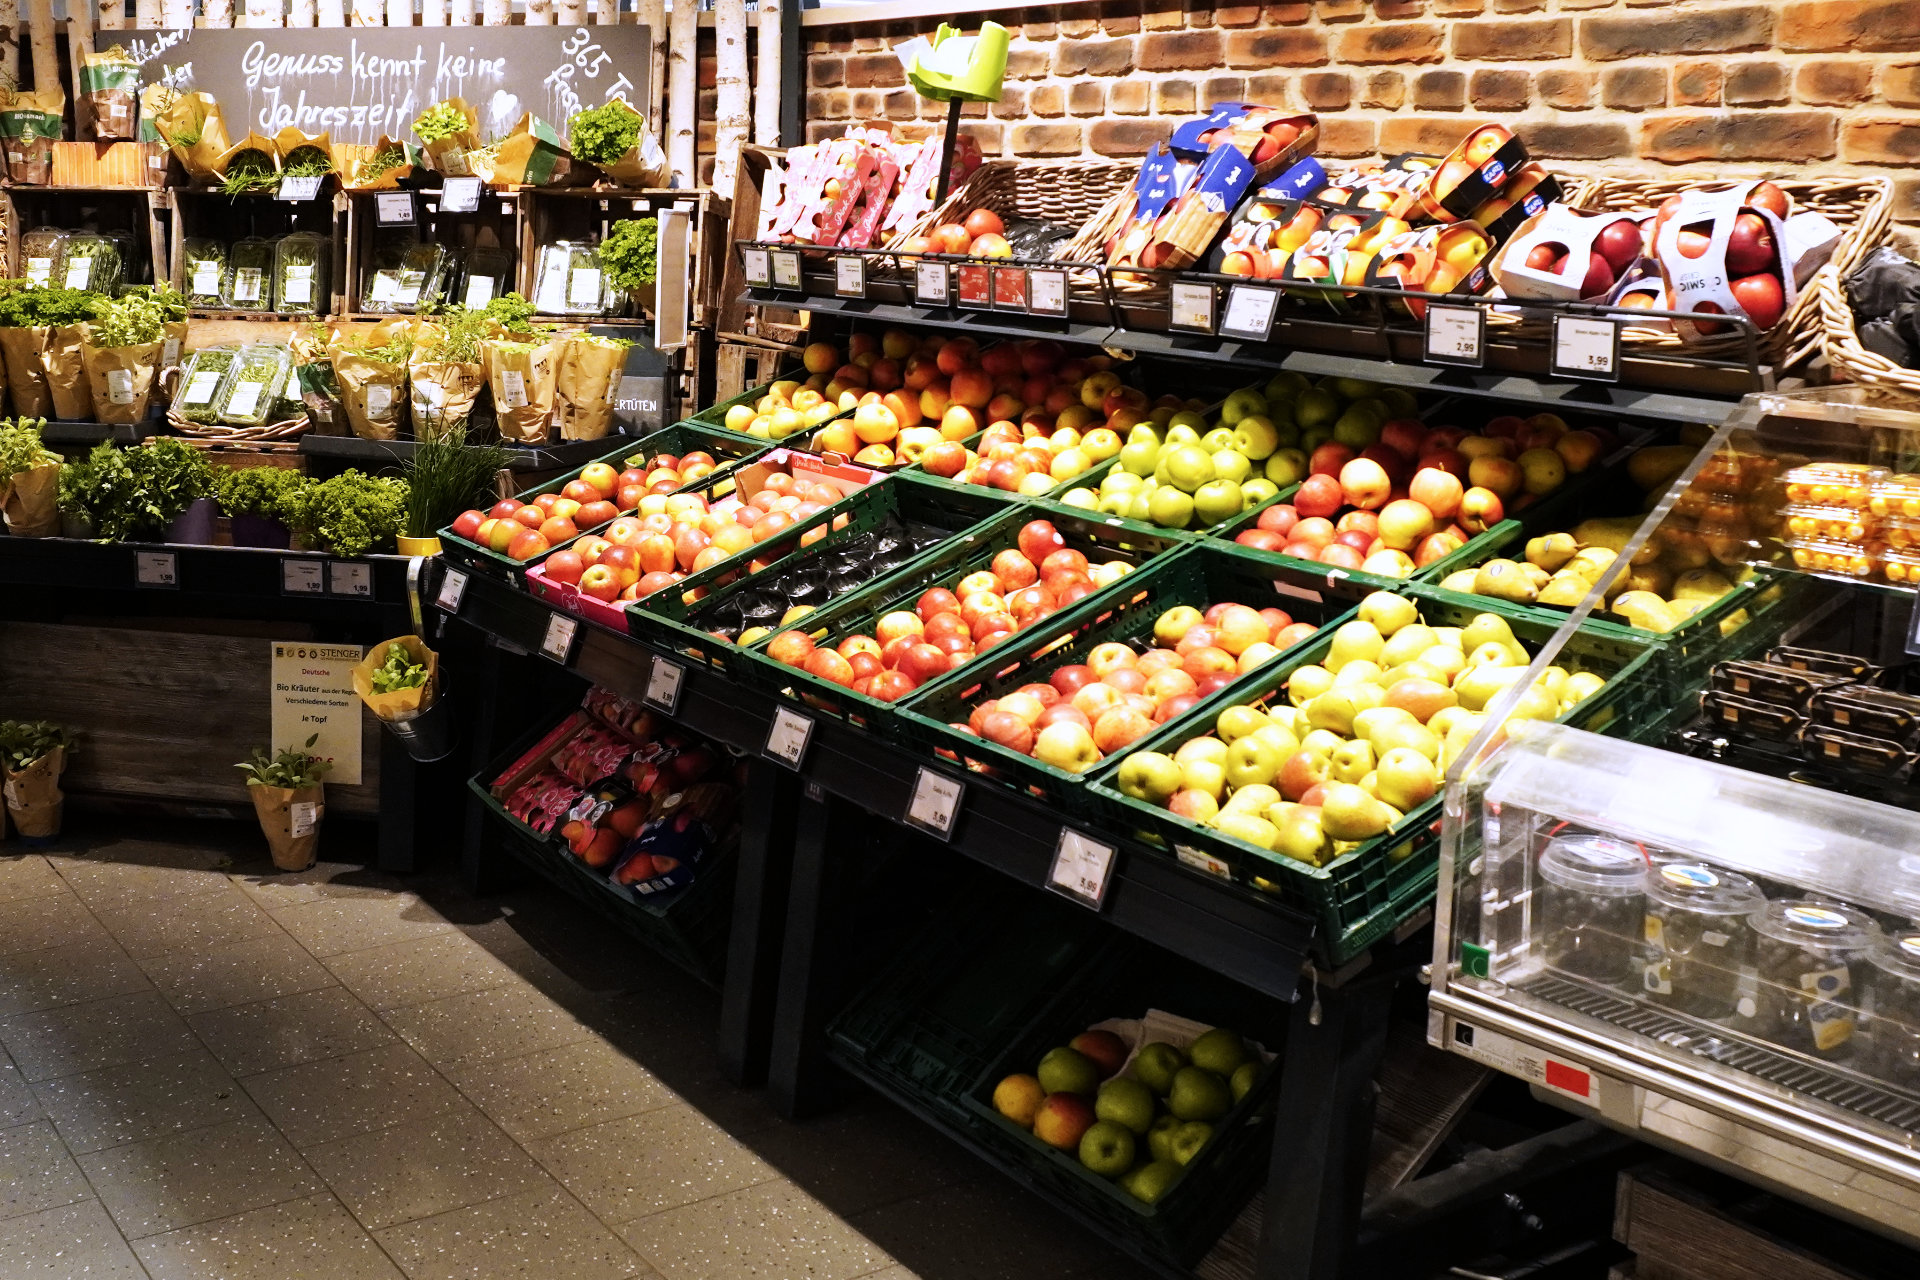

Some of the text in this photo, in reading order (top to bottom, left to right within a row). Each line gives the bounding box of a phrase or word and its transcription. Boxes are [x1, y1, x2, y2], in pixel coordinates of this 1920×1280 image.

[562, 27, 612, 78] 365
[242, 38, 506, 87] Genuss kennt keine
[258, 85, 414, 129] Jahreszeit
[834, 198, 850, 226] Pink
[1249, 318, 1265, 328] 2,99
[1457, 342, 1475, 353] 2,99
[1588, 355, 1609, 366] 3,99
[614, 398, 657, 412] ERTÜTEN
[160, 574, 173, 582] 1,99
[320, 648, 360, 658] STENGER
[302, 668, 330, 676] Deutsche
[276, 683, 289, 691] Bio
[291, 684, 320, 693] Kräuter
[285, 697, 349, 707] Verschiedene Sorten
[311, 715, 327, 724] Topf
[932, 811, 948, 825] 3,99
[1080, 877, 1098, 893] 3,99
